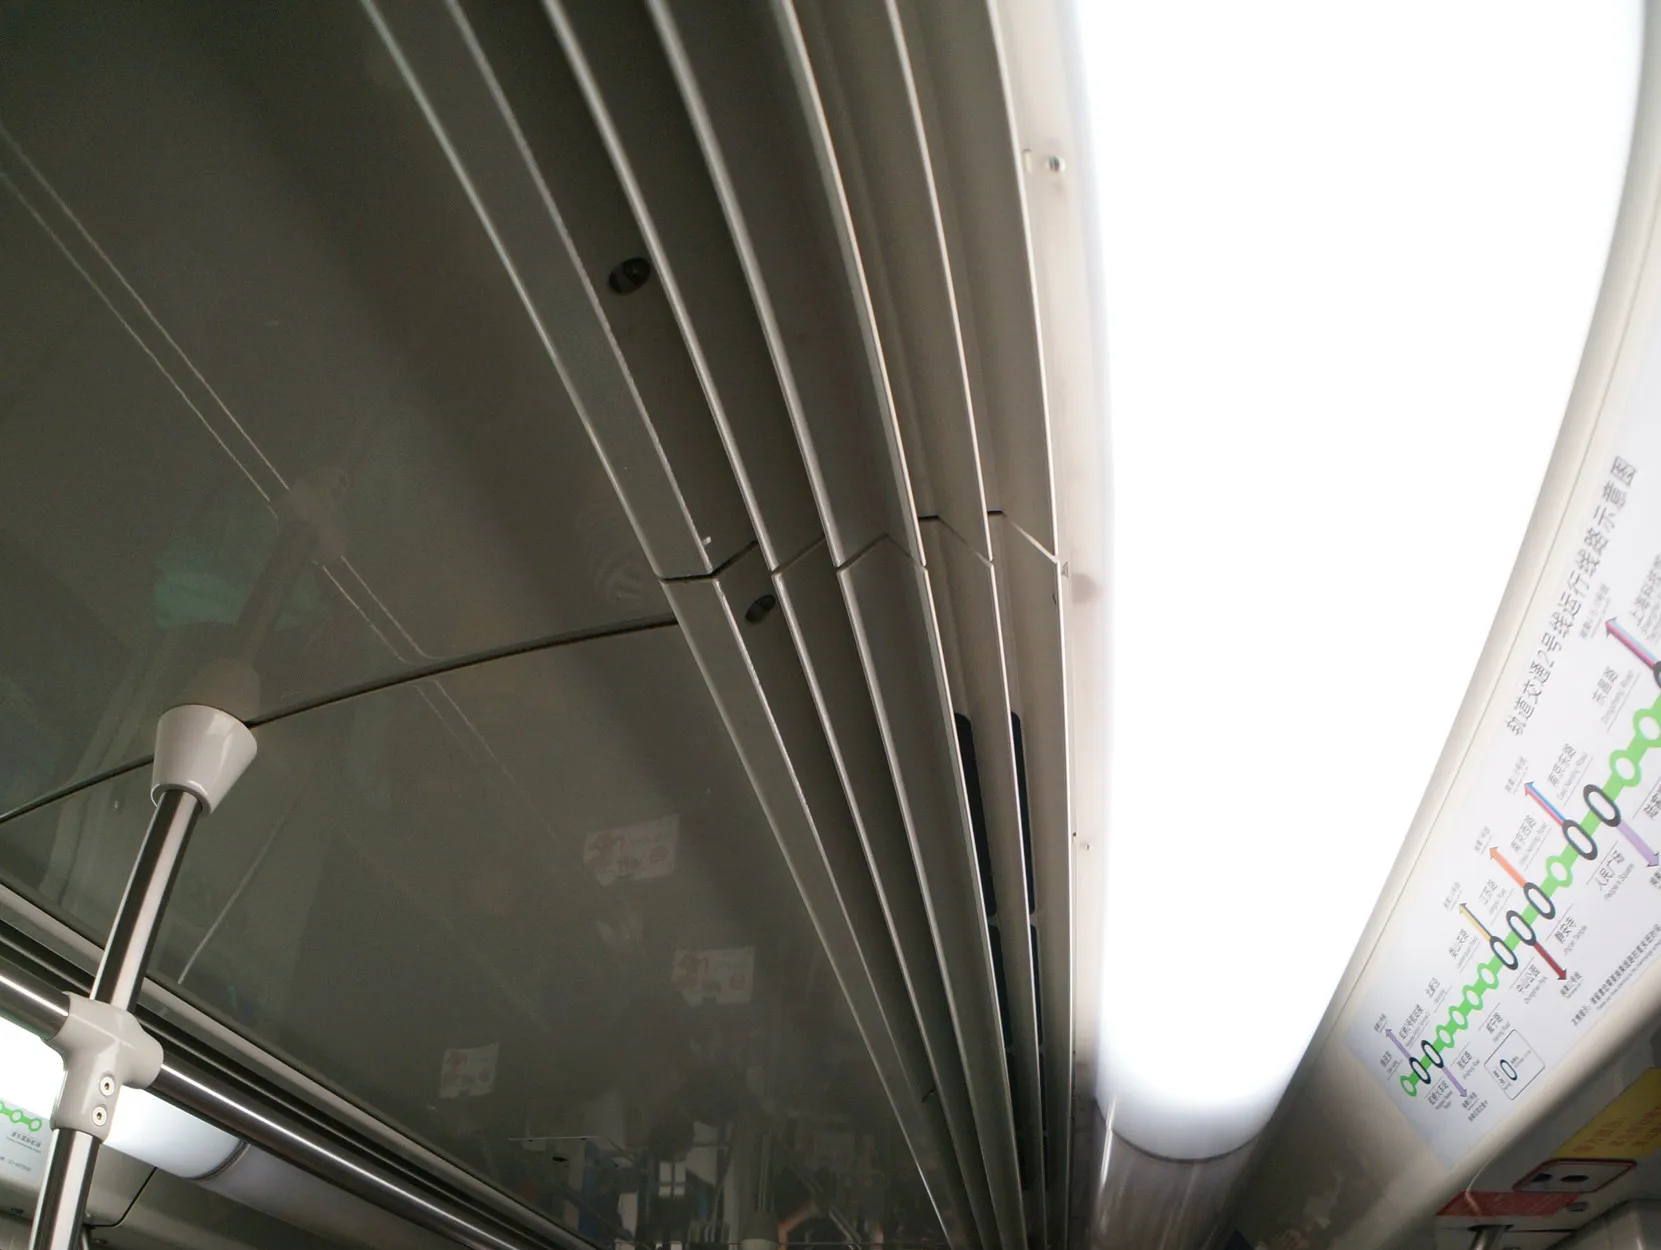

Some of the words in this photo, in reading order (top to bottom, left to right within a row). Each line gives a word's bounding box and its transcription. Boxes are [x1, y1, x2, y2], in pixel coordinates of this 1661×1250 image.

[1504, 455, 1637, 736] 轨道交通2号线运行线路示意图
